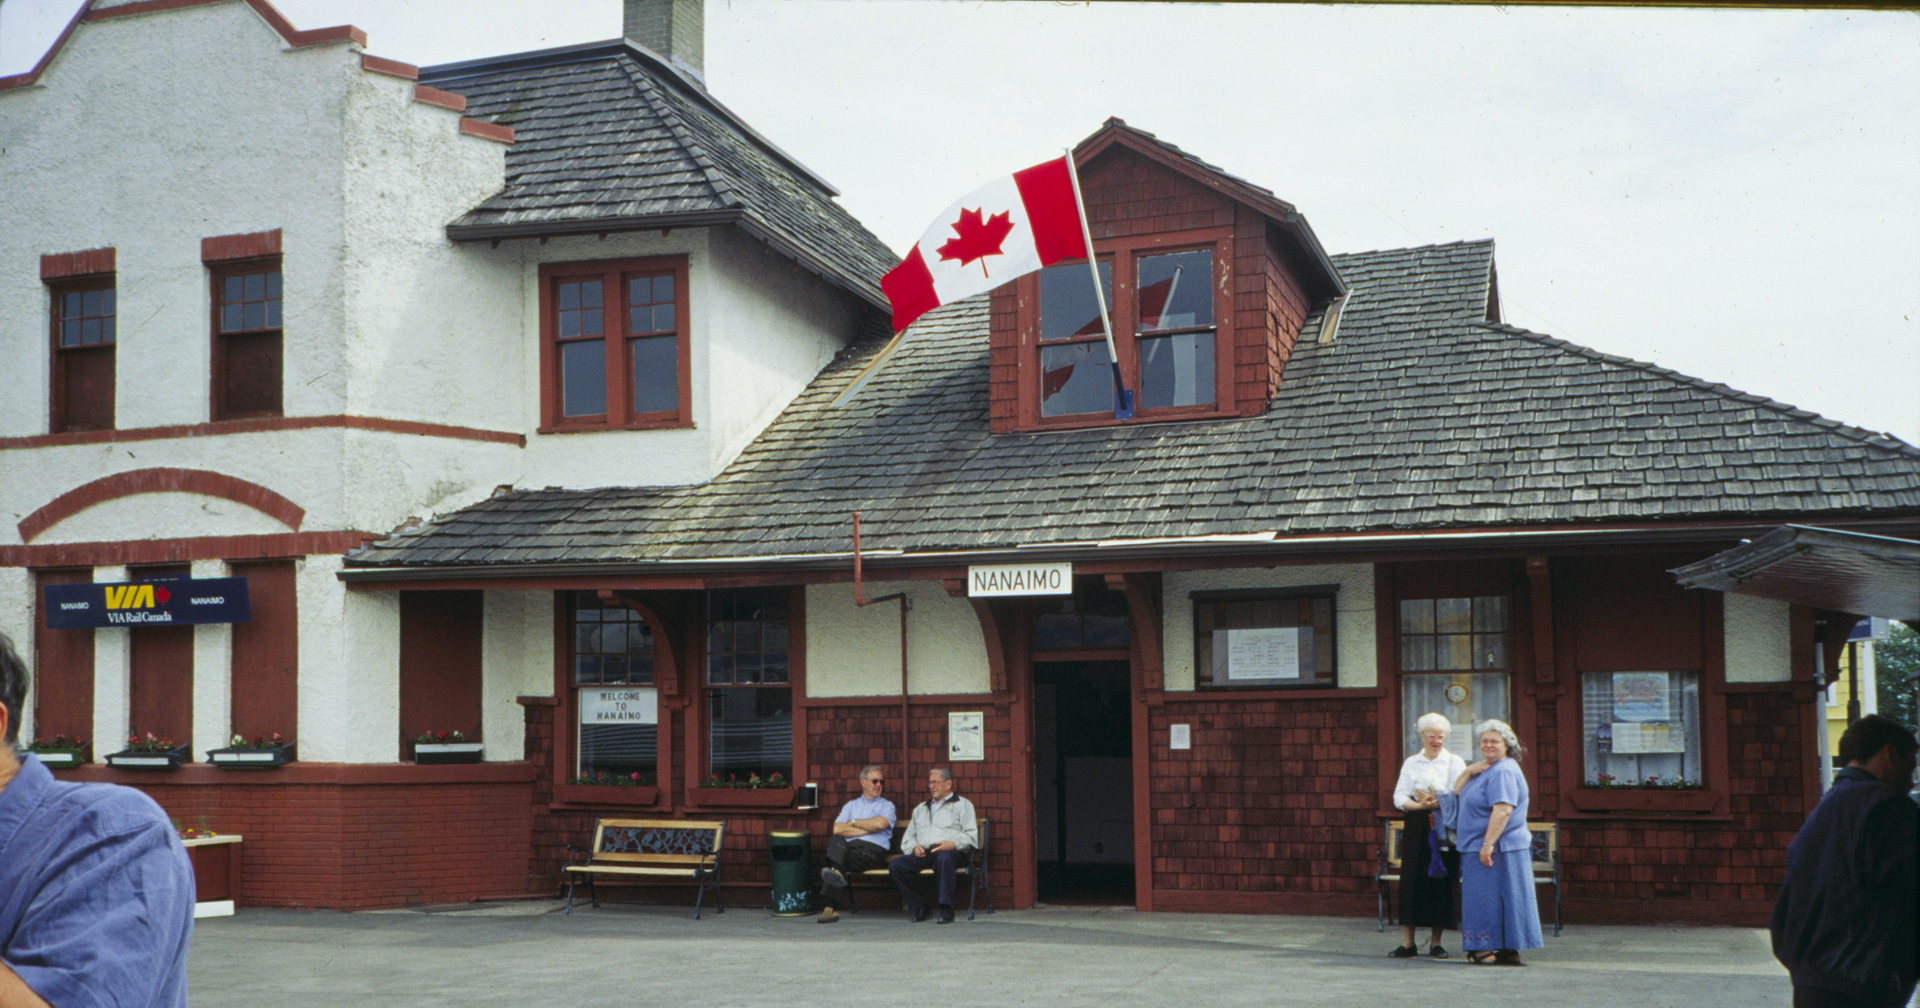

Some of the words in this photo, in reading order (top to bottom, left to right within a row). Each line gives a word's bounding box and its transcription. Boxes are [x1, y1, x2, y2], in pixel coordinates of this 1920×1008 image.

[974, 569, 1061, 592] NANAIMO
[105, 585, 155, 609] VIA
[191, 596, 224, 605] NANAIMO
[60, 602, 90, 610] NANAIMO
[107, 613, 126, 623] VIA
[126, 612, 142, 622] Rail
[142, 611, 172, 622] Canada
[600, 692, 640, 701] WELCOME
[615, 702, 627, 711] TO
[597, 712, 642, 720] NANAIMO
